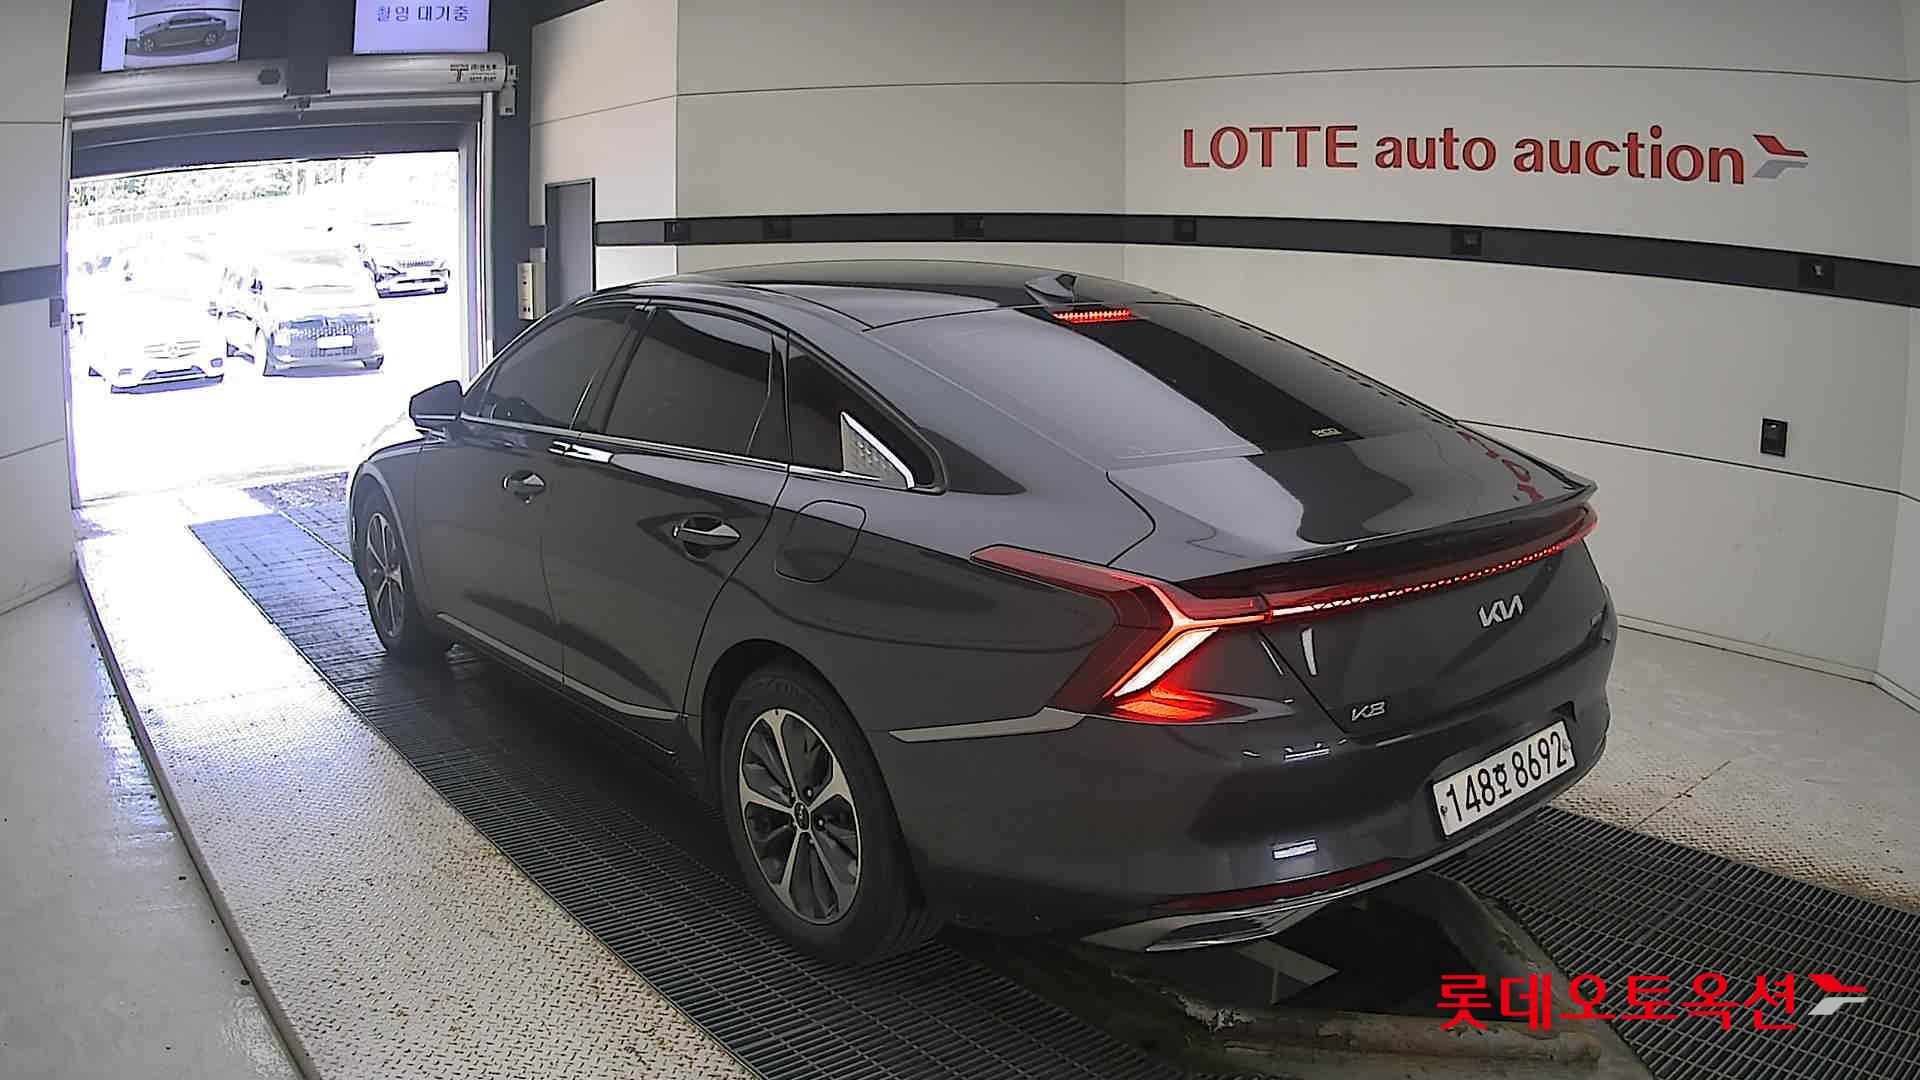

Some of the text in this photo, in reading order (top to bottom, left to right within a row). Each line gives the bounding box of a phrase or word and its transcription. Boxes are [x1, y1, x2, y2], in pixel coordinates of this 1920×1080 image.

[417, 5, 470, 22] 대기중
[1183, 125, 1745, 185] LOTTE auto auction
[1478, 594, 1524, 627] KIA
[1351, 701, 1385, 721] K8
[1511, 731, 1567, 788] 8692
